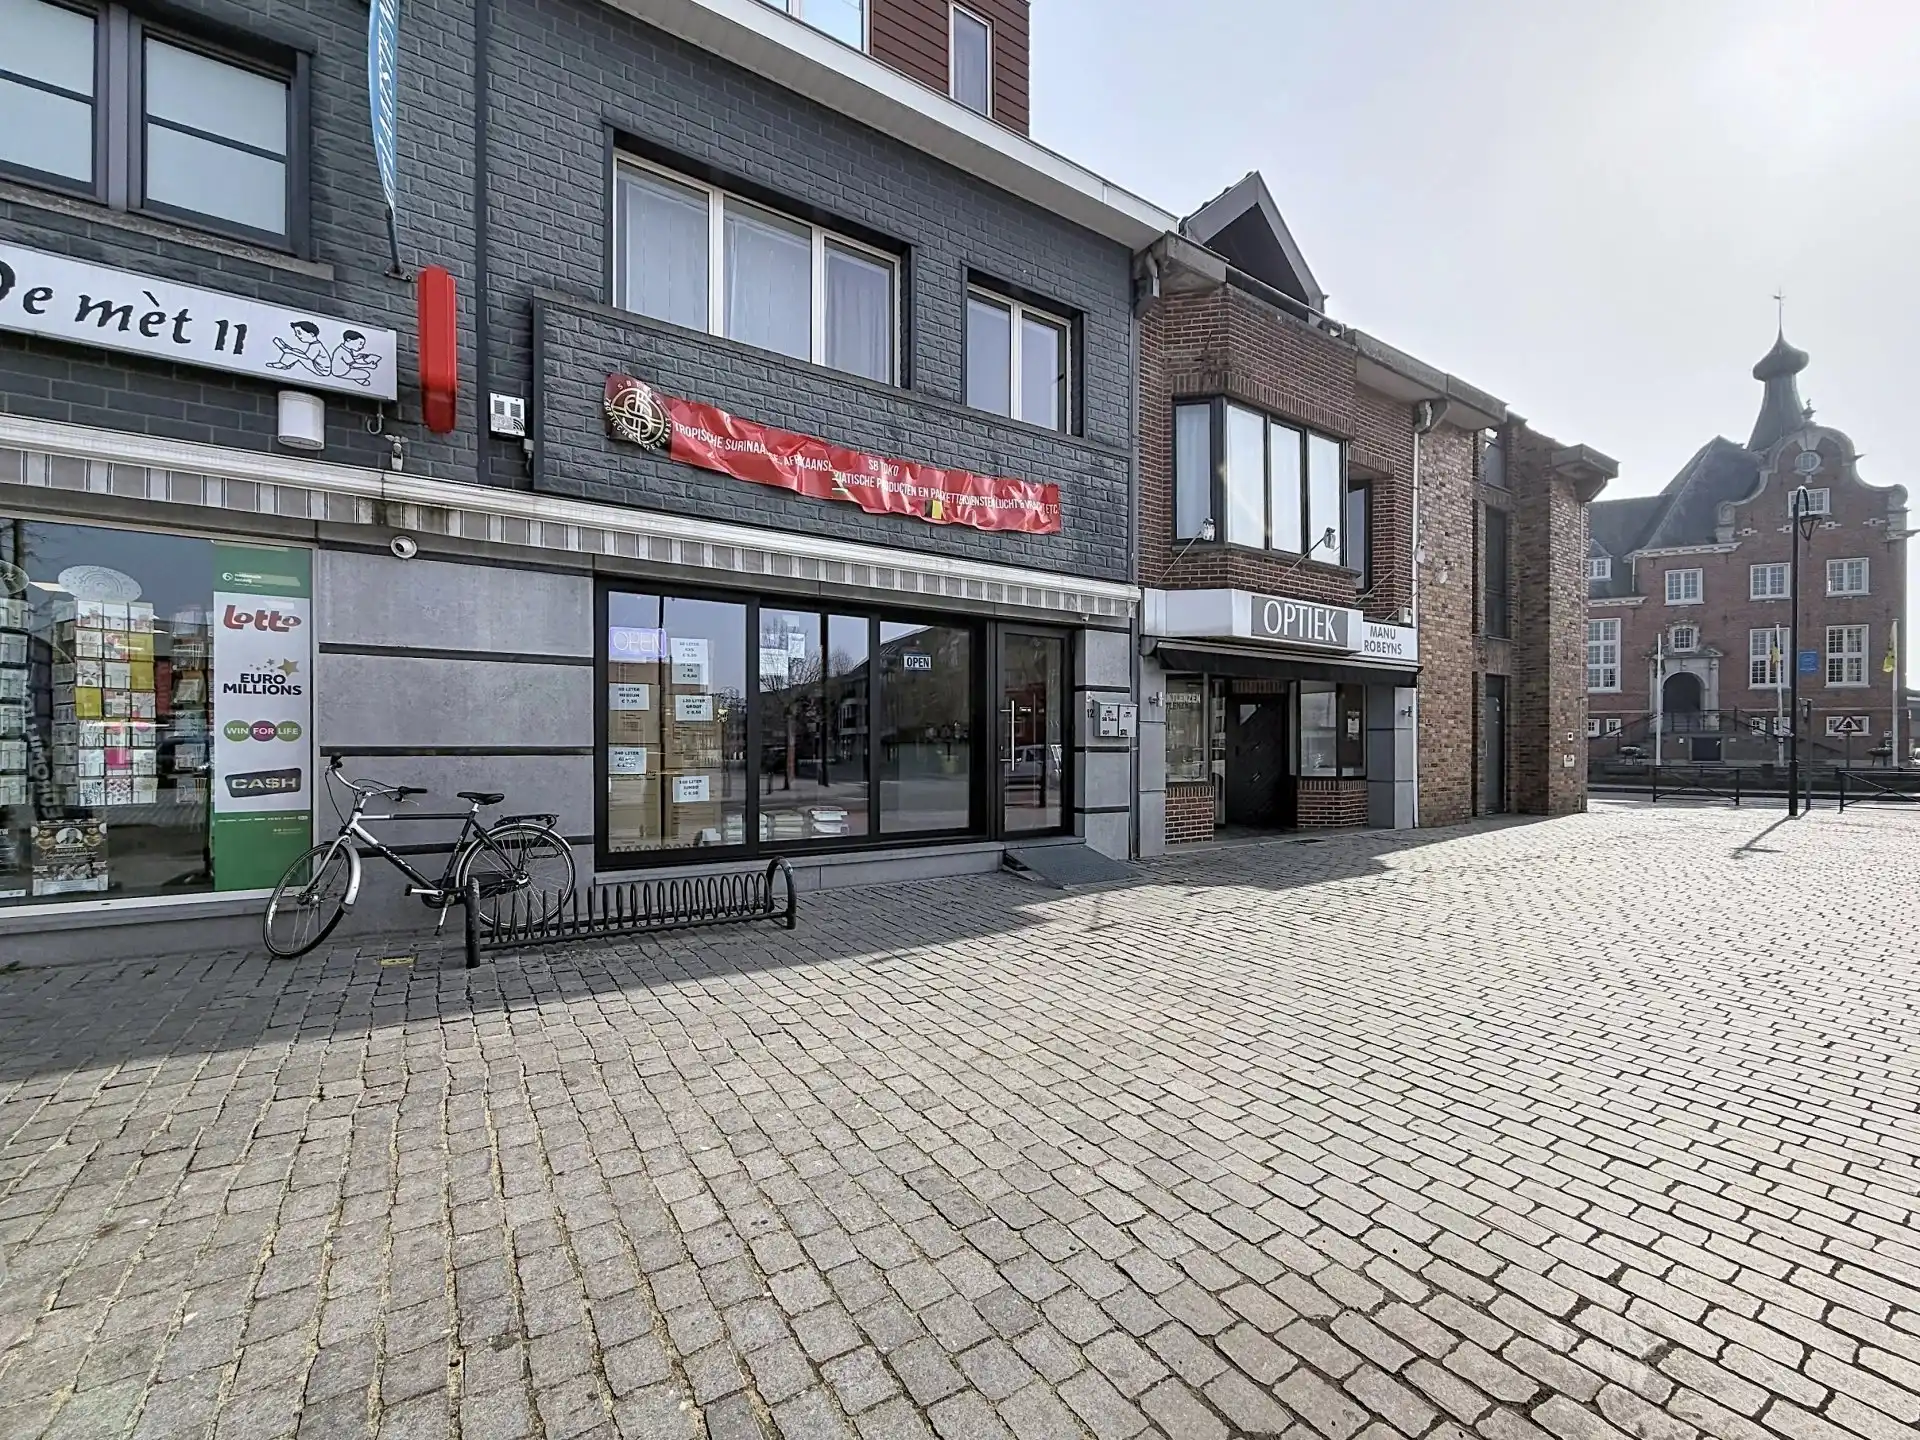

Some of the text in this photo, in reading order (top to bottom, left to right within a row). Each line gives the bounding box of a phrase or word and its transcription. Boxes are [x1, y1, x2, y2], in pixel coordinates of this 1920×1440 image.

[74, 290, 193, 344] mèt
[673, 422, 722, 449] TROPISCHE
[868, 459, 899, 477] SB TOKO
[918, 486, 929, 498] EN
[1263, 600, 1338, 642] OPTIEK
[1369, 625, 1396, 640] MANU
[1364, 640, 1403, 655] ROBEYNS
[906, 656, 930, 668] OPEN
[240, 672, 287, 685] EURO
[223, 683, 303, 696] MILLIONS
[226, 727, 299, 736] WIN FOR LIFE
